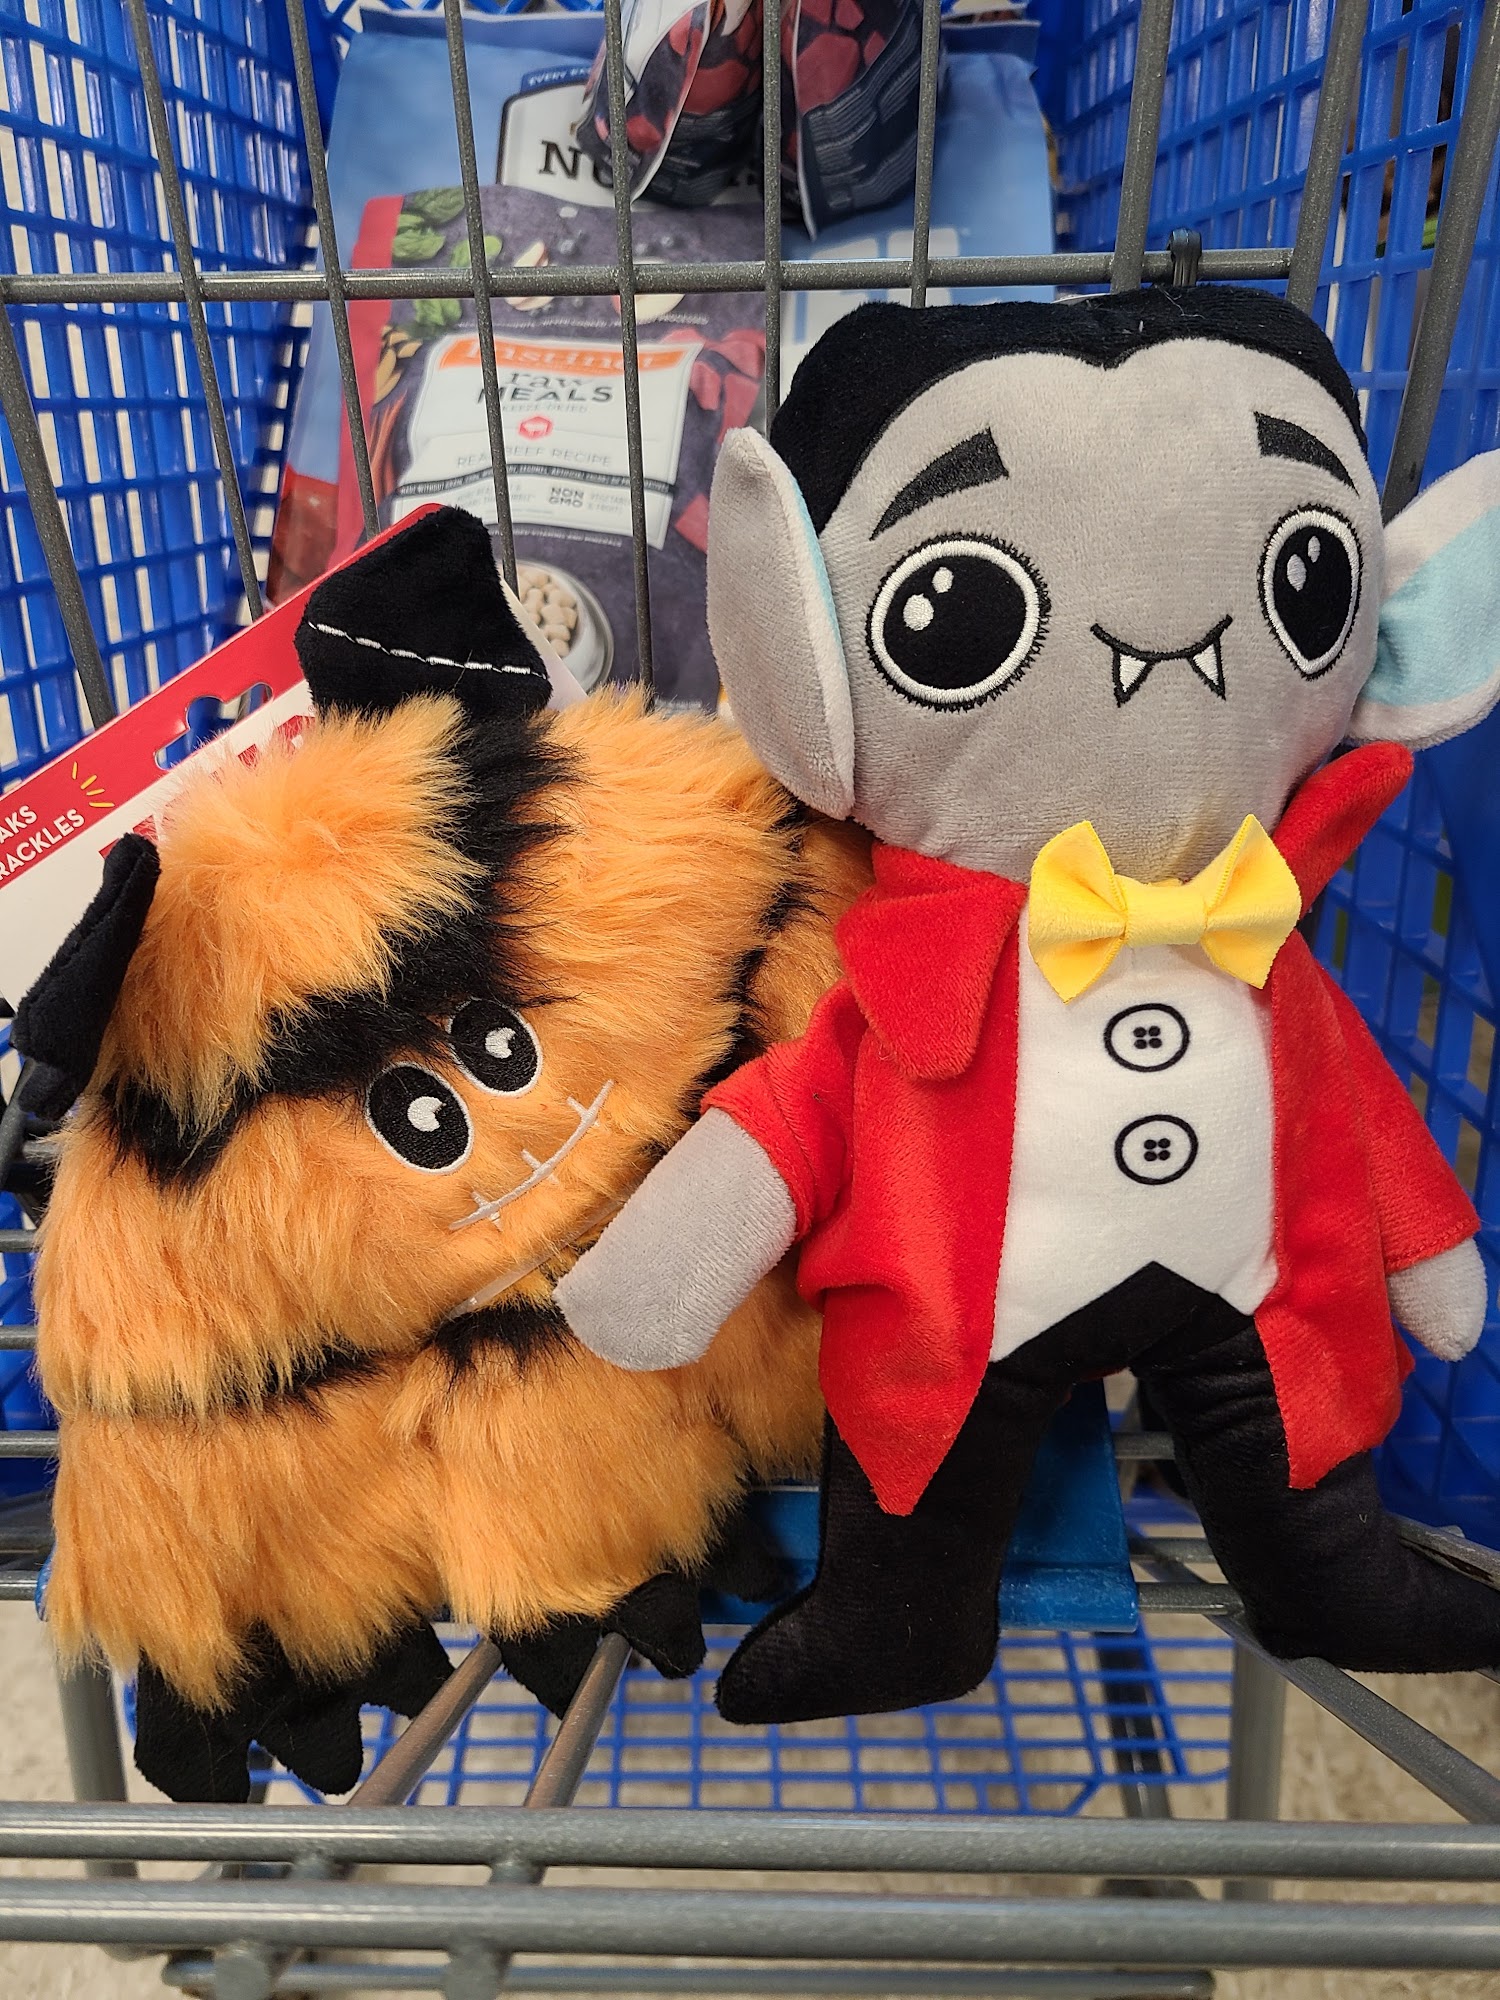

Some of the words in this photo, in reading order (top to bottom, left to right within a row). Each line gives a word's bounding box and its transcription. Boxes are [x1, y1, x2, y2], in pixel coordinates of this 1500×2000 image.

[477, 386, 613, 403] MEALS
[457, 455, 491, 469] REA
[551, 447, 614, 467] RECIPE
[551, 487, 584, 499] NON
[548, 496, 583, 508] GMO
